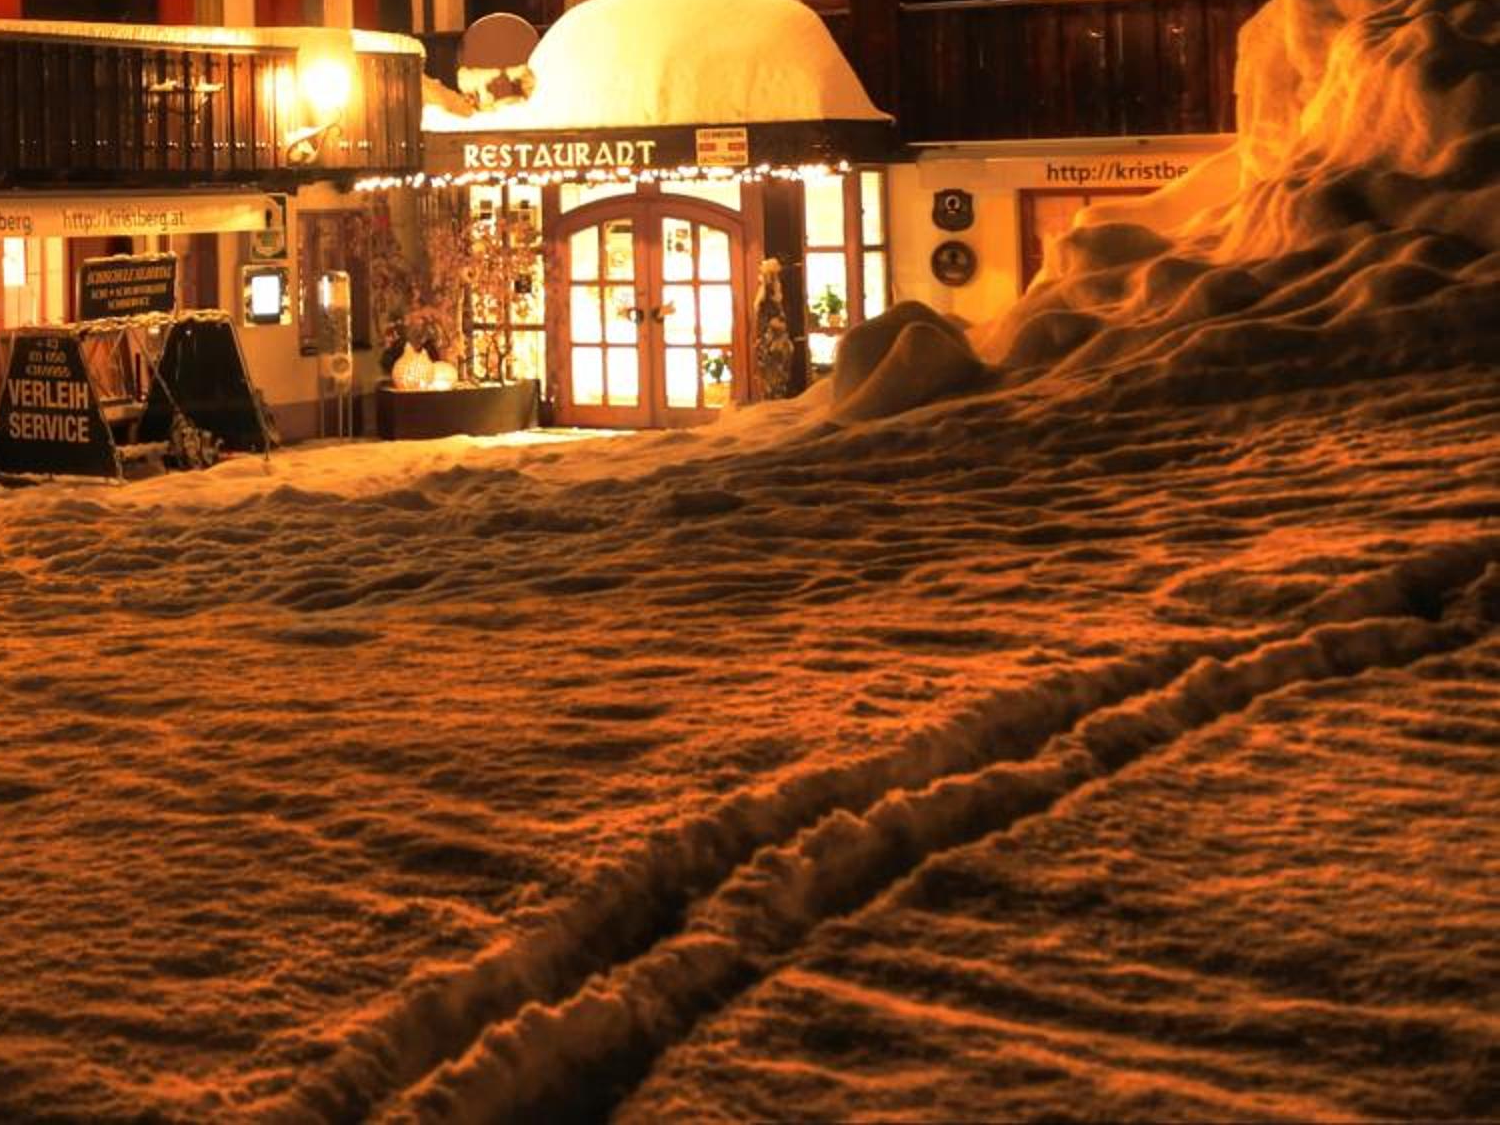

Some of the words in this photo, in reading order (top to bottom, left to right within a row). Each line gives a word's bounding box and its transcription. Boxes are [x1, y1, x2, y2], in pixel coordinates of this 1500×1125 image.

[463, 140, 656, 168] RESTAURANT
[63, 208, 186, 232] http://kristberg.at
[7, 378, 89, 410] VERLEIH
[9, 411, 91, 443] SERVICE
